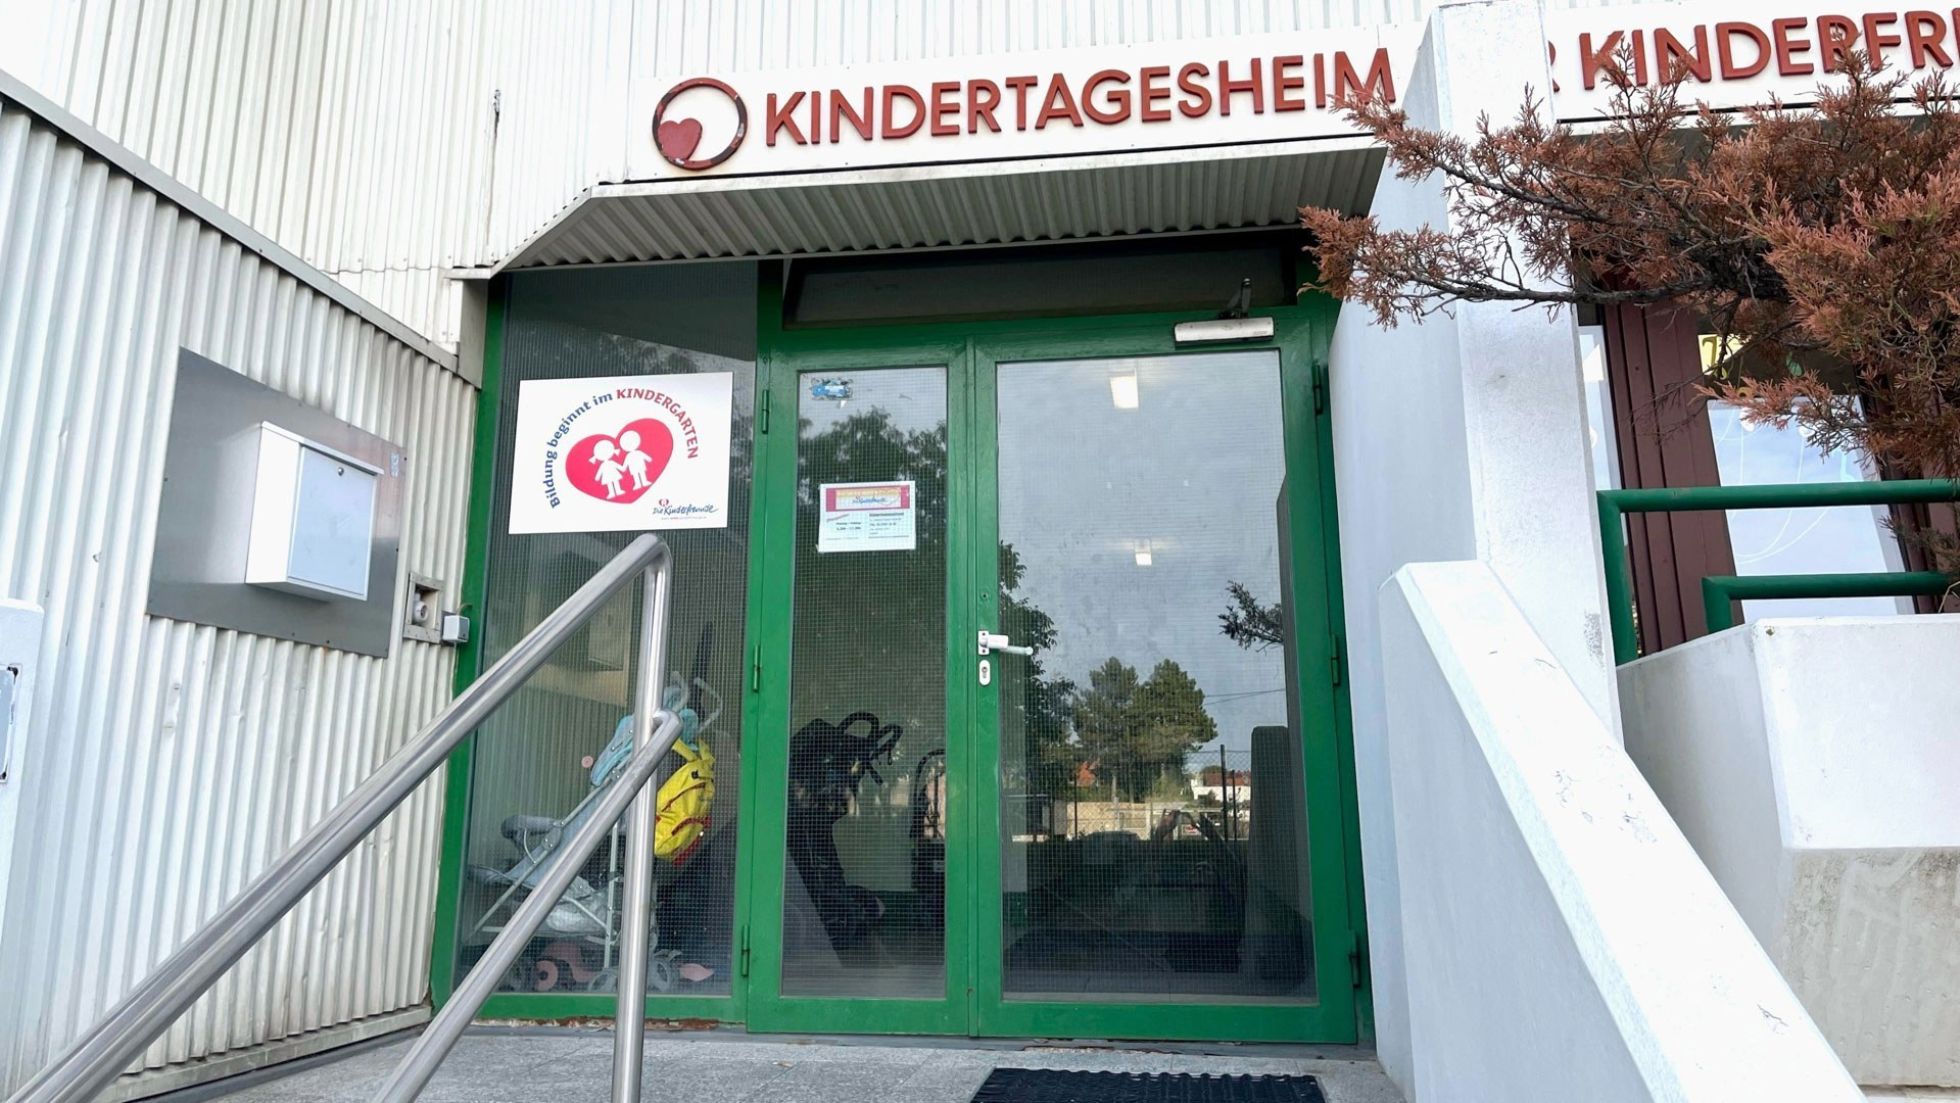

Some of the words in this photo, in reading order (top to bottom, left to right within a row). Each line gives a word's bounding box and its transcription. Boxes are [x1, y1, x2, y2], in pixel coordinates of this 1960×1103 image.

[1579, 7, 1960, 91] KINDERFR
[766, 47, 1396, 147] KINDERTAGESHEIM
[547, 401, 591, 447] beginnt
[593, 393, 613, 406] im
[616, 388, 699, 459] KINDERGARTEN
[543, 449, 561, 509] Bildung
